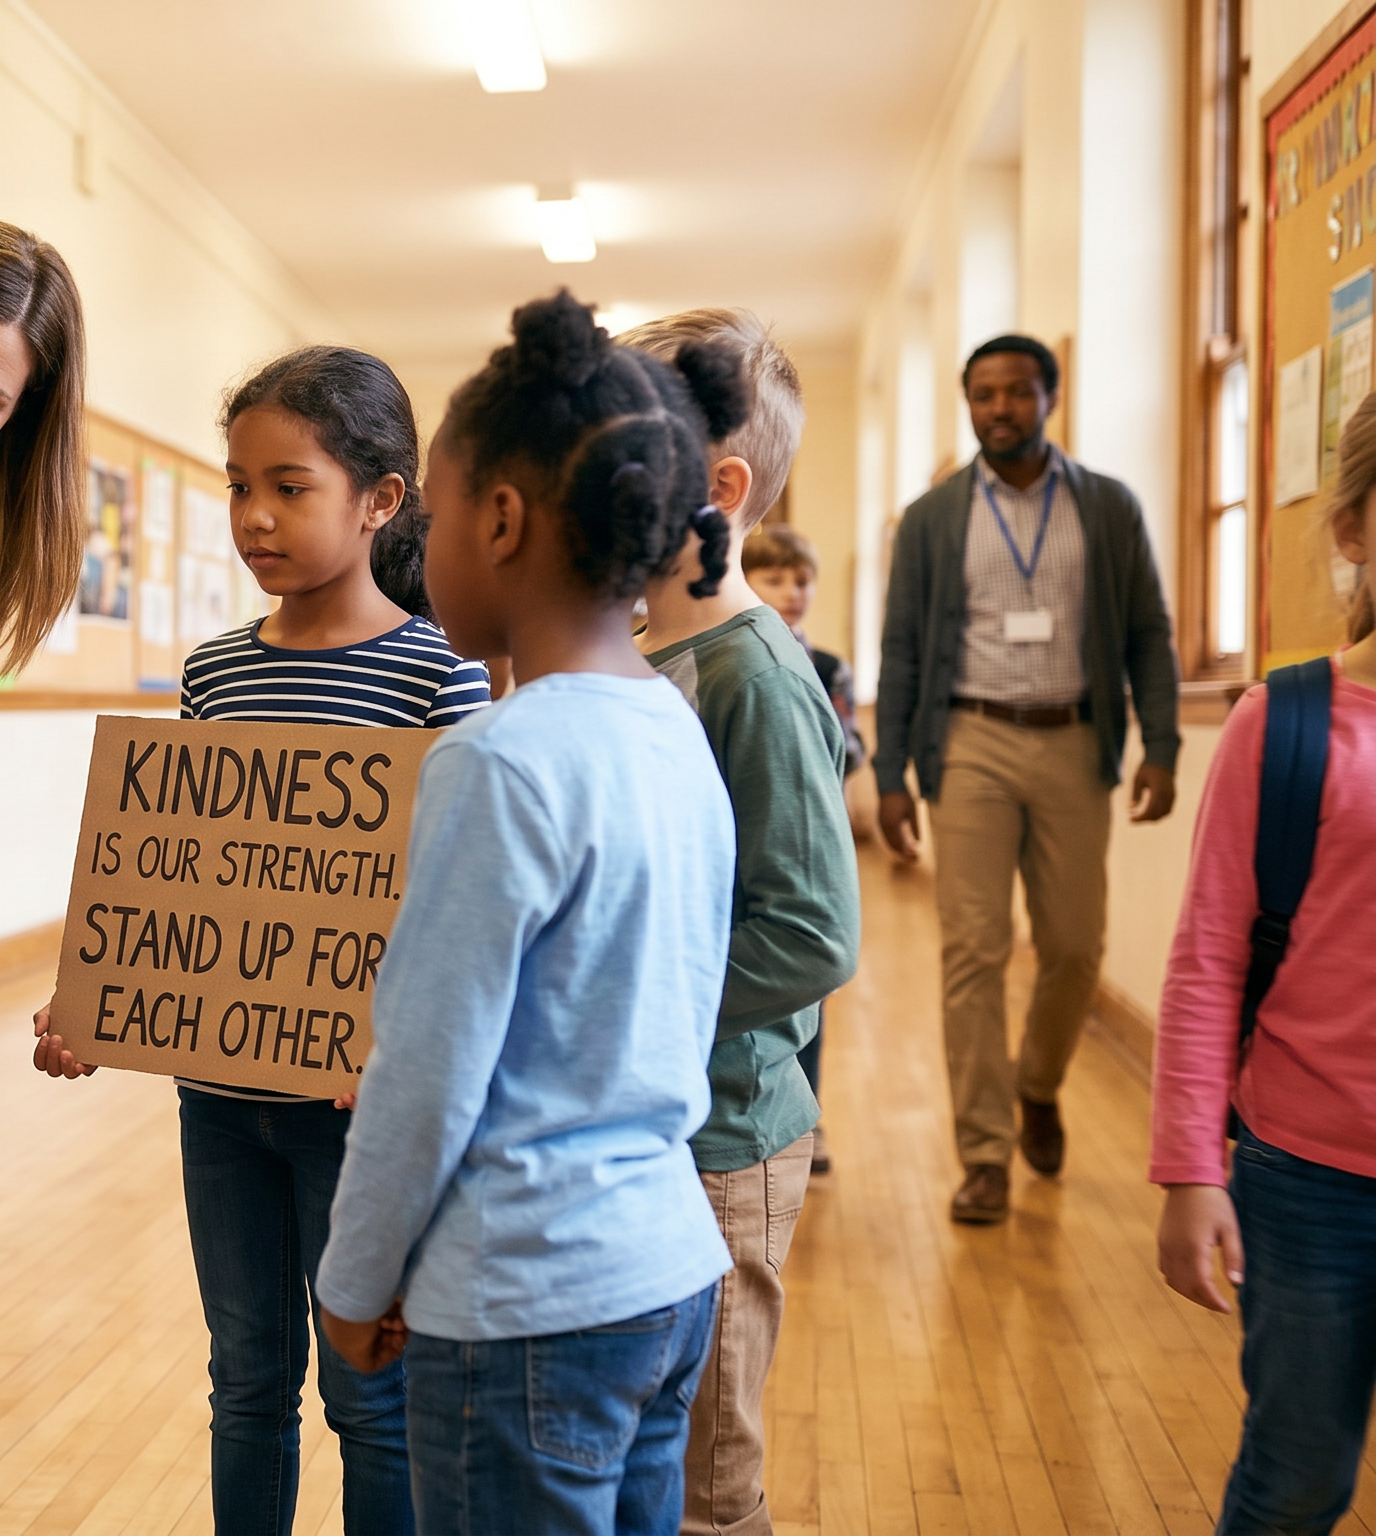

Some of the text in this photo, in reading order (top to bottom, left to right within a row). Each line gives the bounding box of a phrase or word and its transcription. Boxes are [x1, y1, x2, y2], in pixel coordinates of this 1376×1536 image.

[119, 740, 392, 832] KINDNESS
[91, 831, 400, 900] IS OUR STRENGTH.
[79, 903, 388, 992] STAND UP FOR
[94, 985, 363, 1075] EACH OTHER.
